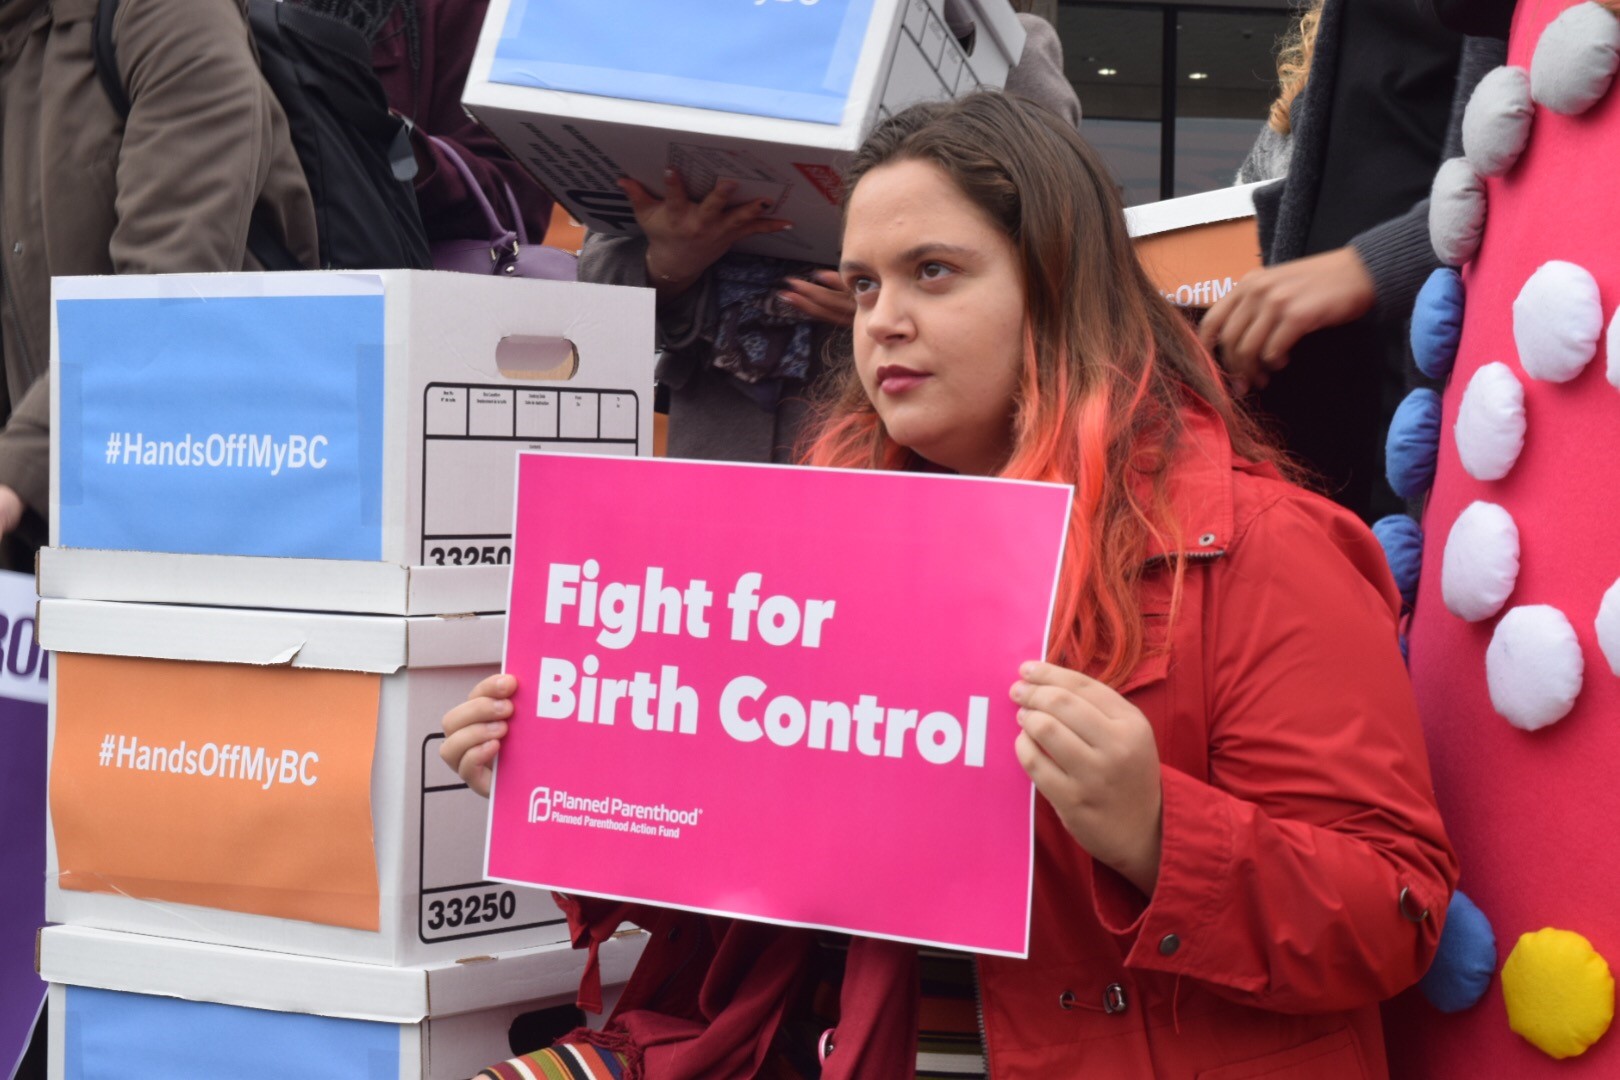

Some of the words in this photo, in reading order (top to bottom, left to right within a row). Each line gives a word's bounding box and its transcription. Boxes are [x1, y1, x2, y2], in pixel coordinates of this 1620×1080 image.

[105, 431, 329, 476] #HandsOffMyBC
[544, 558, 713, 650] Fight
[727, 571, 836, 649] for
[536, 654, 699, 735] Birth
[719, 675, 989, 767] Control
[99, 734, 320, 790] #HandsOffMyBC
[553, 790, 609, 814] Planned
[551, 811, 583, 826] Planned
[583, 816, 629, 832] Parenthood
[630, 821, 657, 836] Action
[658, 825, 681, 839] Fund
[427, 890, 516, 931] 33250
